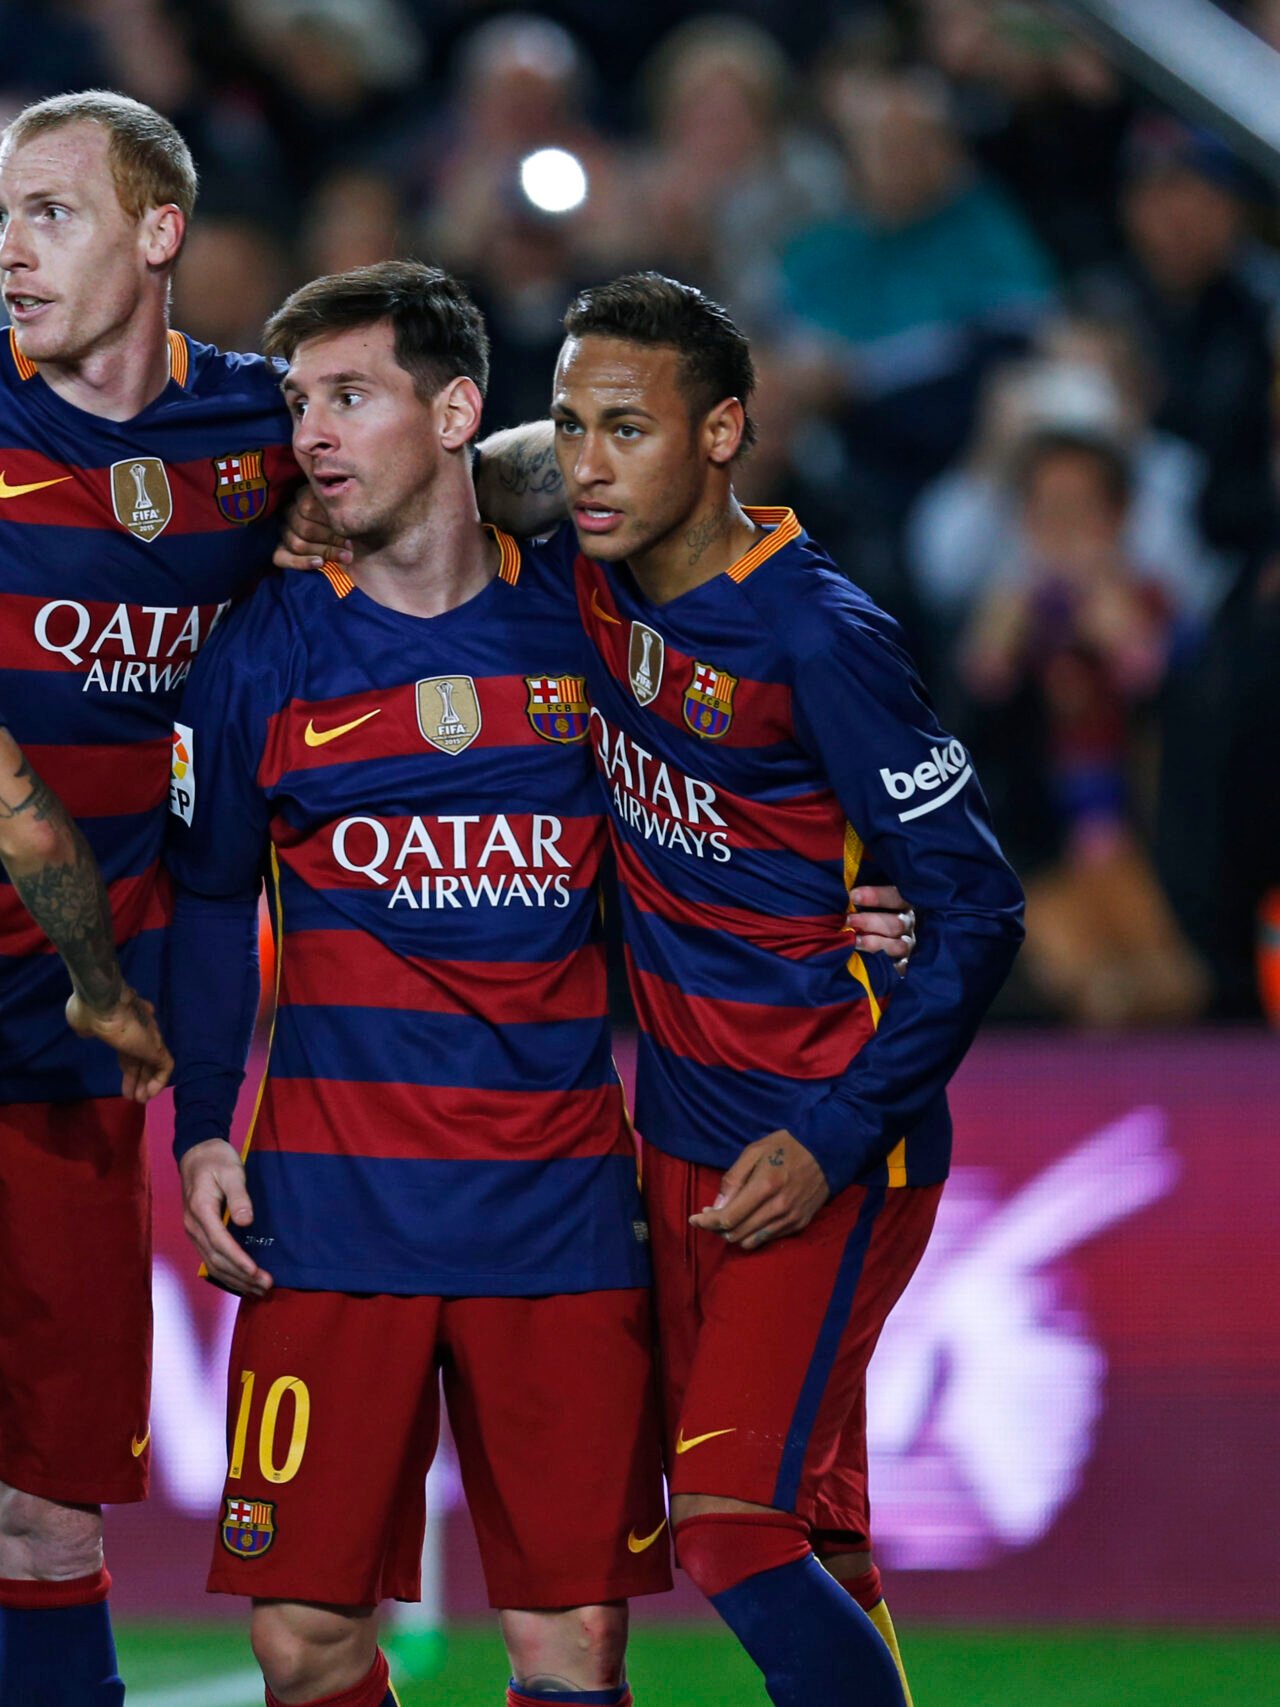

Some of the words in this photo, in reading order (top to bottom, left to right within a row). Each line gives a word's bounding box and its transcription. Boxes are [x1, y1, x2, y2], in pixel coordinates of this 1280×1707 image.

[231, 483, 252, 492] FCB
[132, 509, 160, 522] FIFA
[547, 704, 572, 713] FCB
[438, 725, 465, 735] FIFA
[444, 738, 461, 746] 2015
[590, 706, 729, 827] QATAR
[880, 739, 966, 799] beko
[613, 781, 732, 862] AIRWAYS
[332, 814, 572, 885] QATAR
[388, 874, 571, 910] AIRWAYS
[229, 1370, 310, 1483] 10
